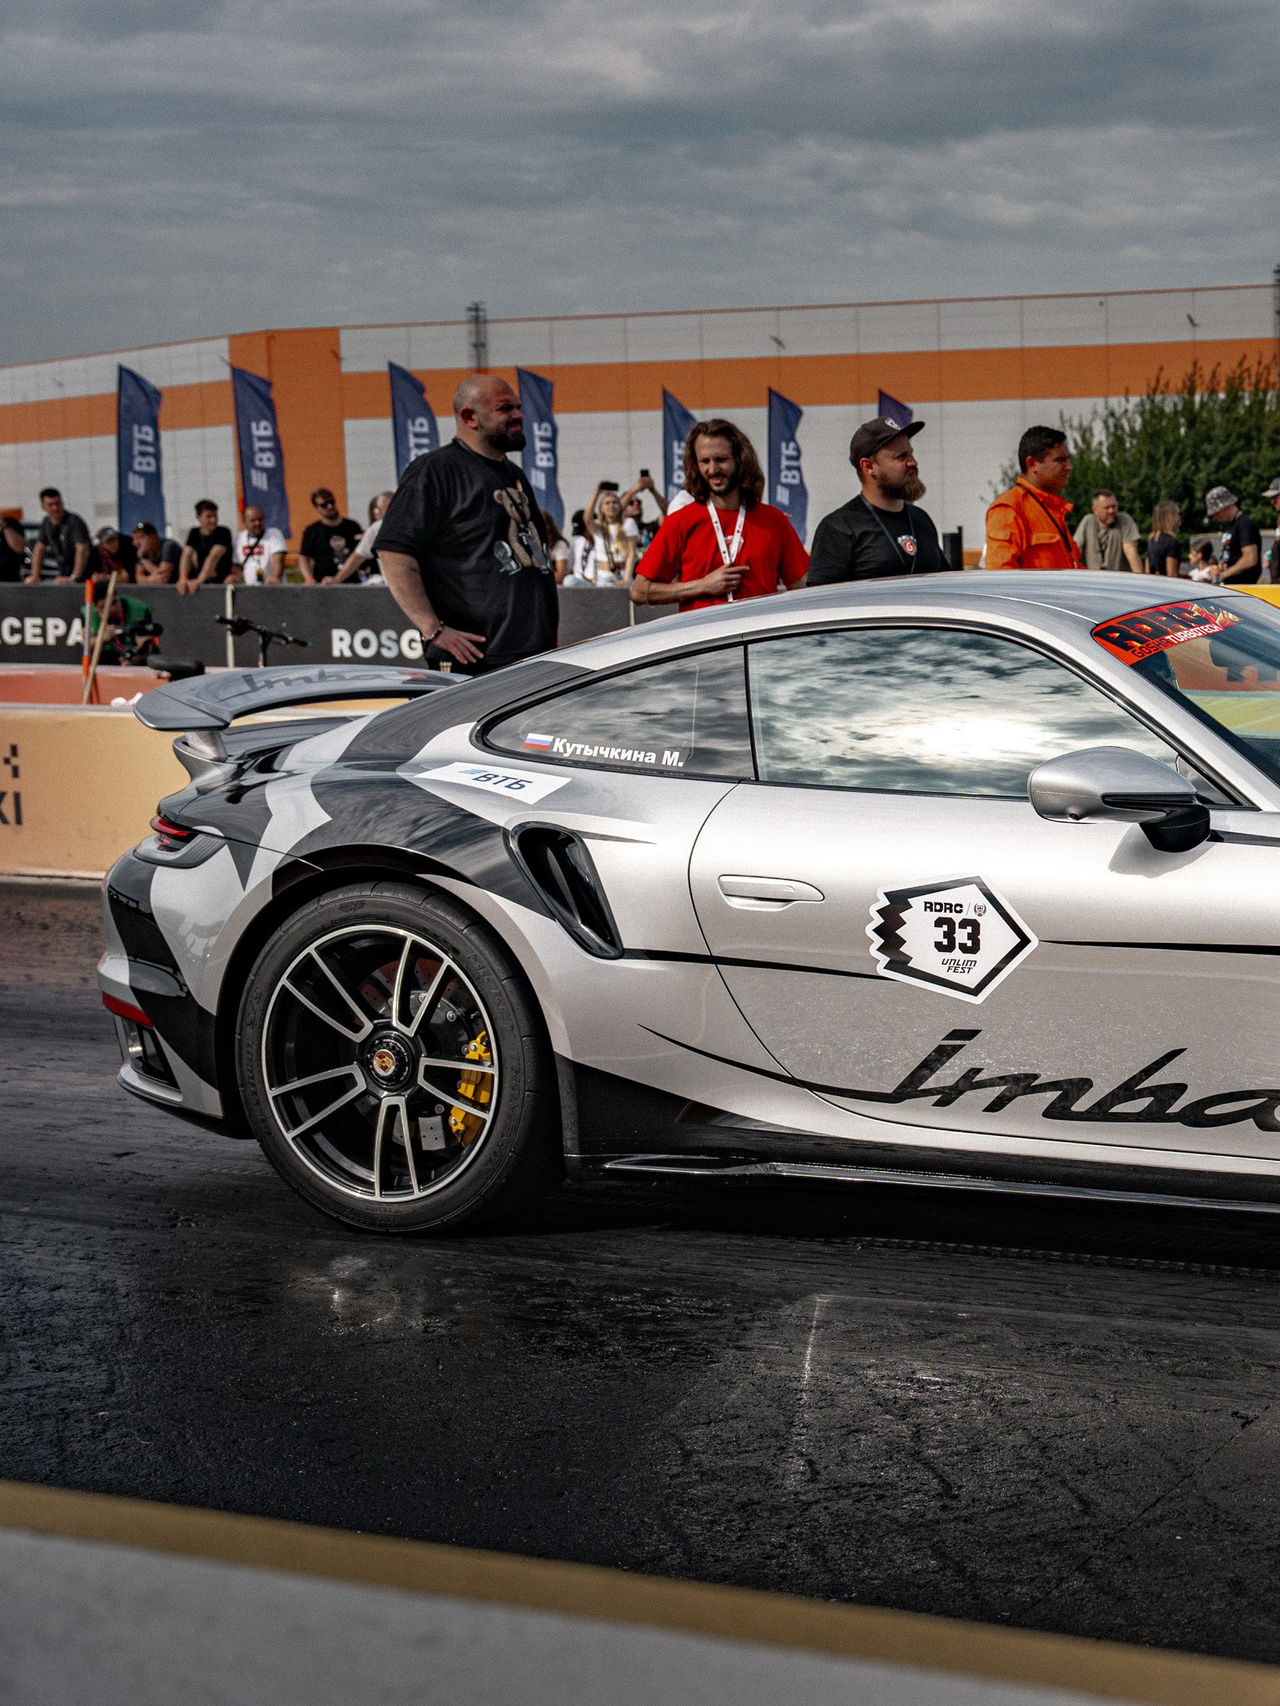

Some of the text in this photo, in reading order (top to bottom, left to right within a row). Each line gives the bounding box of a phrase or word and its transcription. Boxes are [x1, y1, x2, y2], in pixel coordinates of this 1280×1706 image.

[132, 424, 157, 473] ВТБ
[251, 420, 276, 469] ВТБ
[532, 421, 554, 468] ВТБ
[0, 616, 84, 646] CEPA
[331, 628, 424, 660] ROSG
[552, 737, 684, 767] Кутычкина М.
[472, 773, 534, 790] ВТБ
[924, 900, 964, 914] RDRC
[934, 916, 981, 955] 33
[946, 966, 974, 974] FEST
